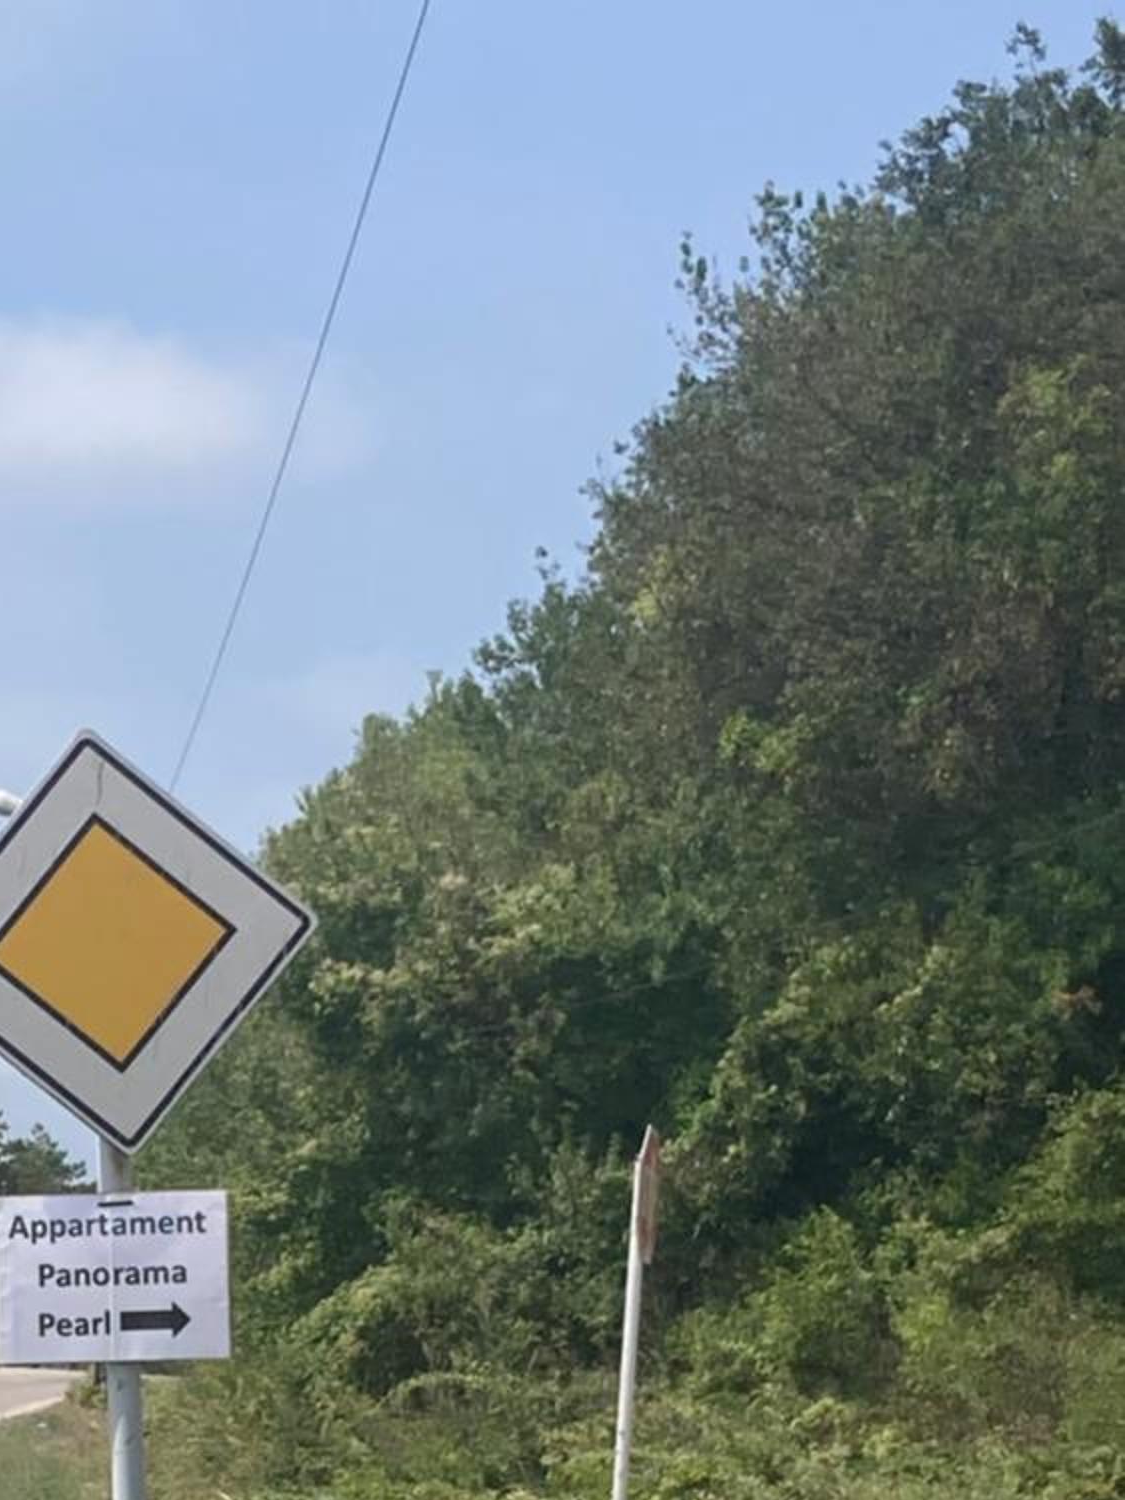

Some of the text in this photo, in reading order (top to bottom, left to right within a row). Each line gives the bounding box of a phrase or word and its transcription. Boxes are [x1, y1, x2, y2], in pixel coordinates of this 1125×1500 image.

[8, 1211, 207, 1244] Appartament
[38, 1263, 188, 1288] Panorama
[38, 1309, 111, 1337] Pearl
